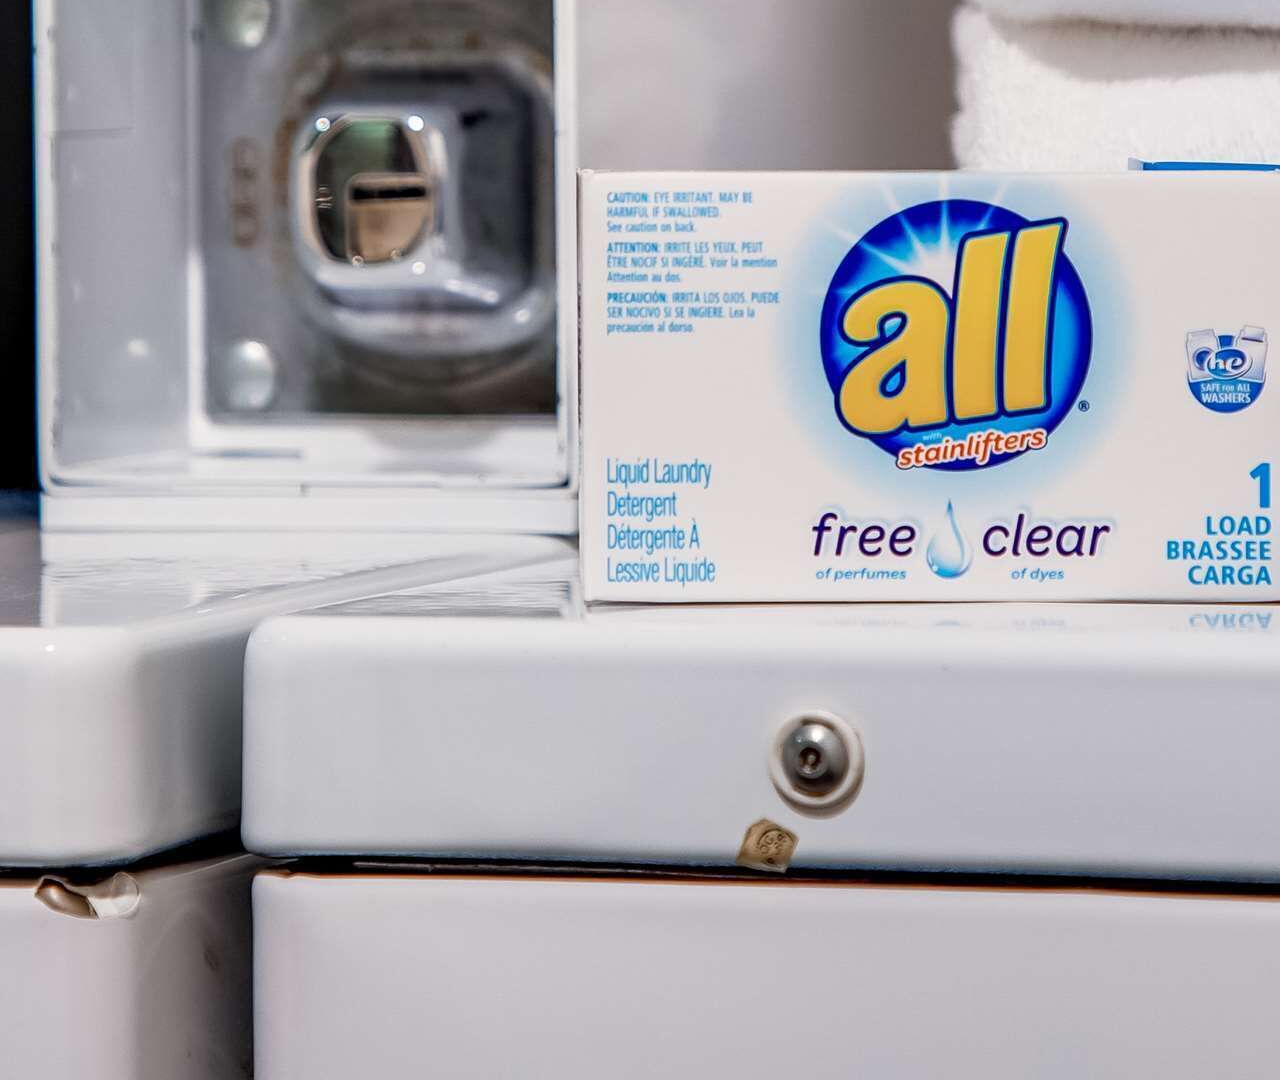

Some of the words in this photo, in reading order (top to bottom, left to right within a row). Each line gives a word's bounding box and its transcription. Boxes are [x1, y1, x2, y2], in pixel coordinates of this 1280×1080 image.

[607, 192, 649, 203] CAUTION:
[653, 192, 670, 203] EYE
[719, 192, 738, 203] MAY
[742, 192, 752, 203] BE
[607, 207, 649, 218] HARMFUL
[652, 207, 660, 218] IF
[607, 222, 622, 233] See
[625, 222, 657, 233] caution
[660, 222, 672, 233] on
[607, 242, 659, 253] ATTENTION:
[664, 242, 691, 253] IRRITE
[695, 242, 709, 253] LES
[741, 242, 763, 253] PEUT
[607, 256, 628, 268] ÊTRE
[631, 258, 657, 268] NOCIF
[661, 258, 669, 268] SI
[710, 258, 727, 268] Voir
[731, 257, 738, 268] la
[741, 257, 778, 268] mention
[607, 272, 648, 283] Attention
[652, 272, 662, 283] au
[672, 292, 700, 303] IRRITA
[704, 292, 720, 303] LOS
[751, 292, 780, 303] PUEDE
[607, 307, 623, 318] SER
[626, 307, 661, 318] NOCIVO
[663, 307, 671, 318] SI
[674, 307, 685, 318] SE
[729, 307, 744, 318] Lea
[747, 307, 755, 318] la
[607, 322, 654, 336] precaución
[657, 322, 665, 333] al
[836, 217, 1068, 437] all
[1200, 383, 1220, 392] SAFE
[1237, 383, 1251, 392] ALL
[1201, 393, 1251, 403] WASHERS
[922, 432, 942, 441] with
[898, 430, 1046, 468] stainlifters
[607, 458, 650, 489] Liquid
[654, 458, 712, 489] Laundry
[1249, 462, 1271, 508] 1
[607, 491, 677, 522] Detergent
[1206, 515, 1272, 536] LOAD
[607, 522, 685, 555] Détergente
[689, 517, 700, 549] À
[812, 512, 917, 557] free
[982, 513, 1111, 557] clear
[1166, 540, 1272, 560] BRASSEE
[607, 557, 660, 582] Lessive
[664, 557, 716, 589] Liquide
[815, 567, 832, 580] of
[834, 567, 907, 583] perfumes
[1010, 567, 1029, 580] of
[1030, 567, 1065, 583] dyes
[1187, 565, 1272, 585] CARGA
